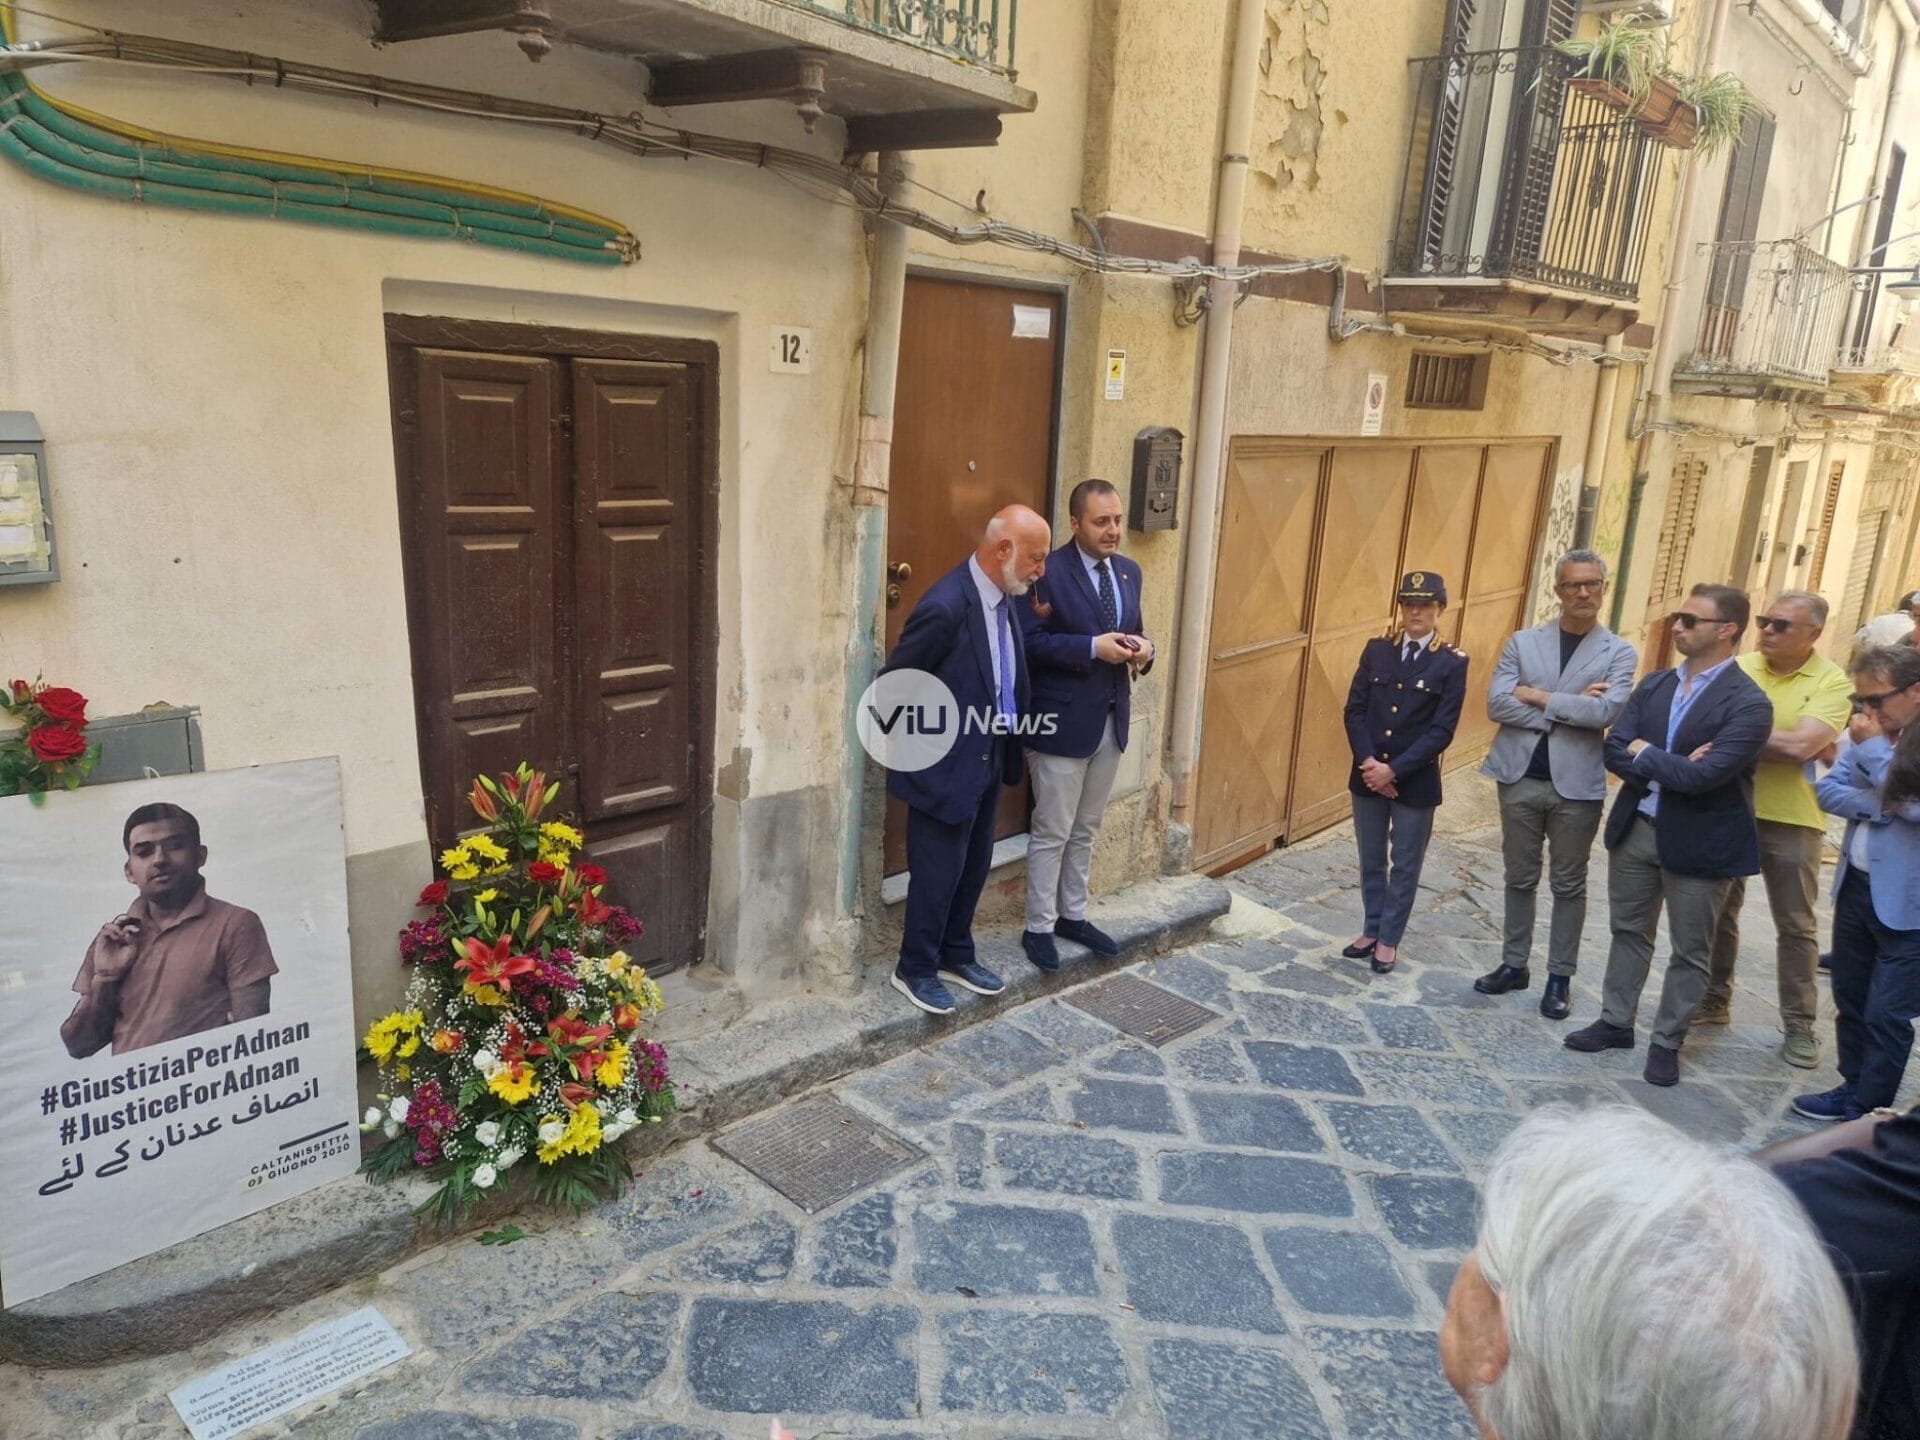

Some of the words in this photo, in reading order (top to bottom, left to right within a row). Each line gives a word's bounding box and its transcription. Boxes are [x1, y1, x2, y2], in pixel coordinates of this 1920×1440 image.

[780, 334, 801, 364] 12
[40, 1021, 311, 1115] #GiustiziaPerAdnan
[59, 1056, 300, 1146] #JusticeForAdnan
[232, 1077, 319, 1124] انصاف
[140, 1116, 222, 1161] عدنان
[251, 1133, 350, 1175] CALTANISSETTA
[268, 1155, 317, 1179] GIUGNO
[322, 1143, 350, 1159] 2020
